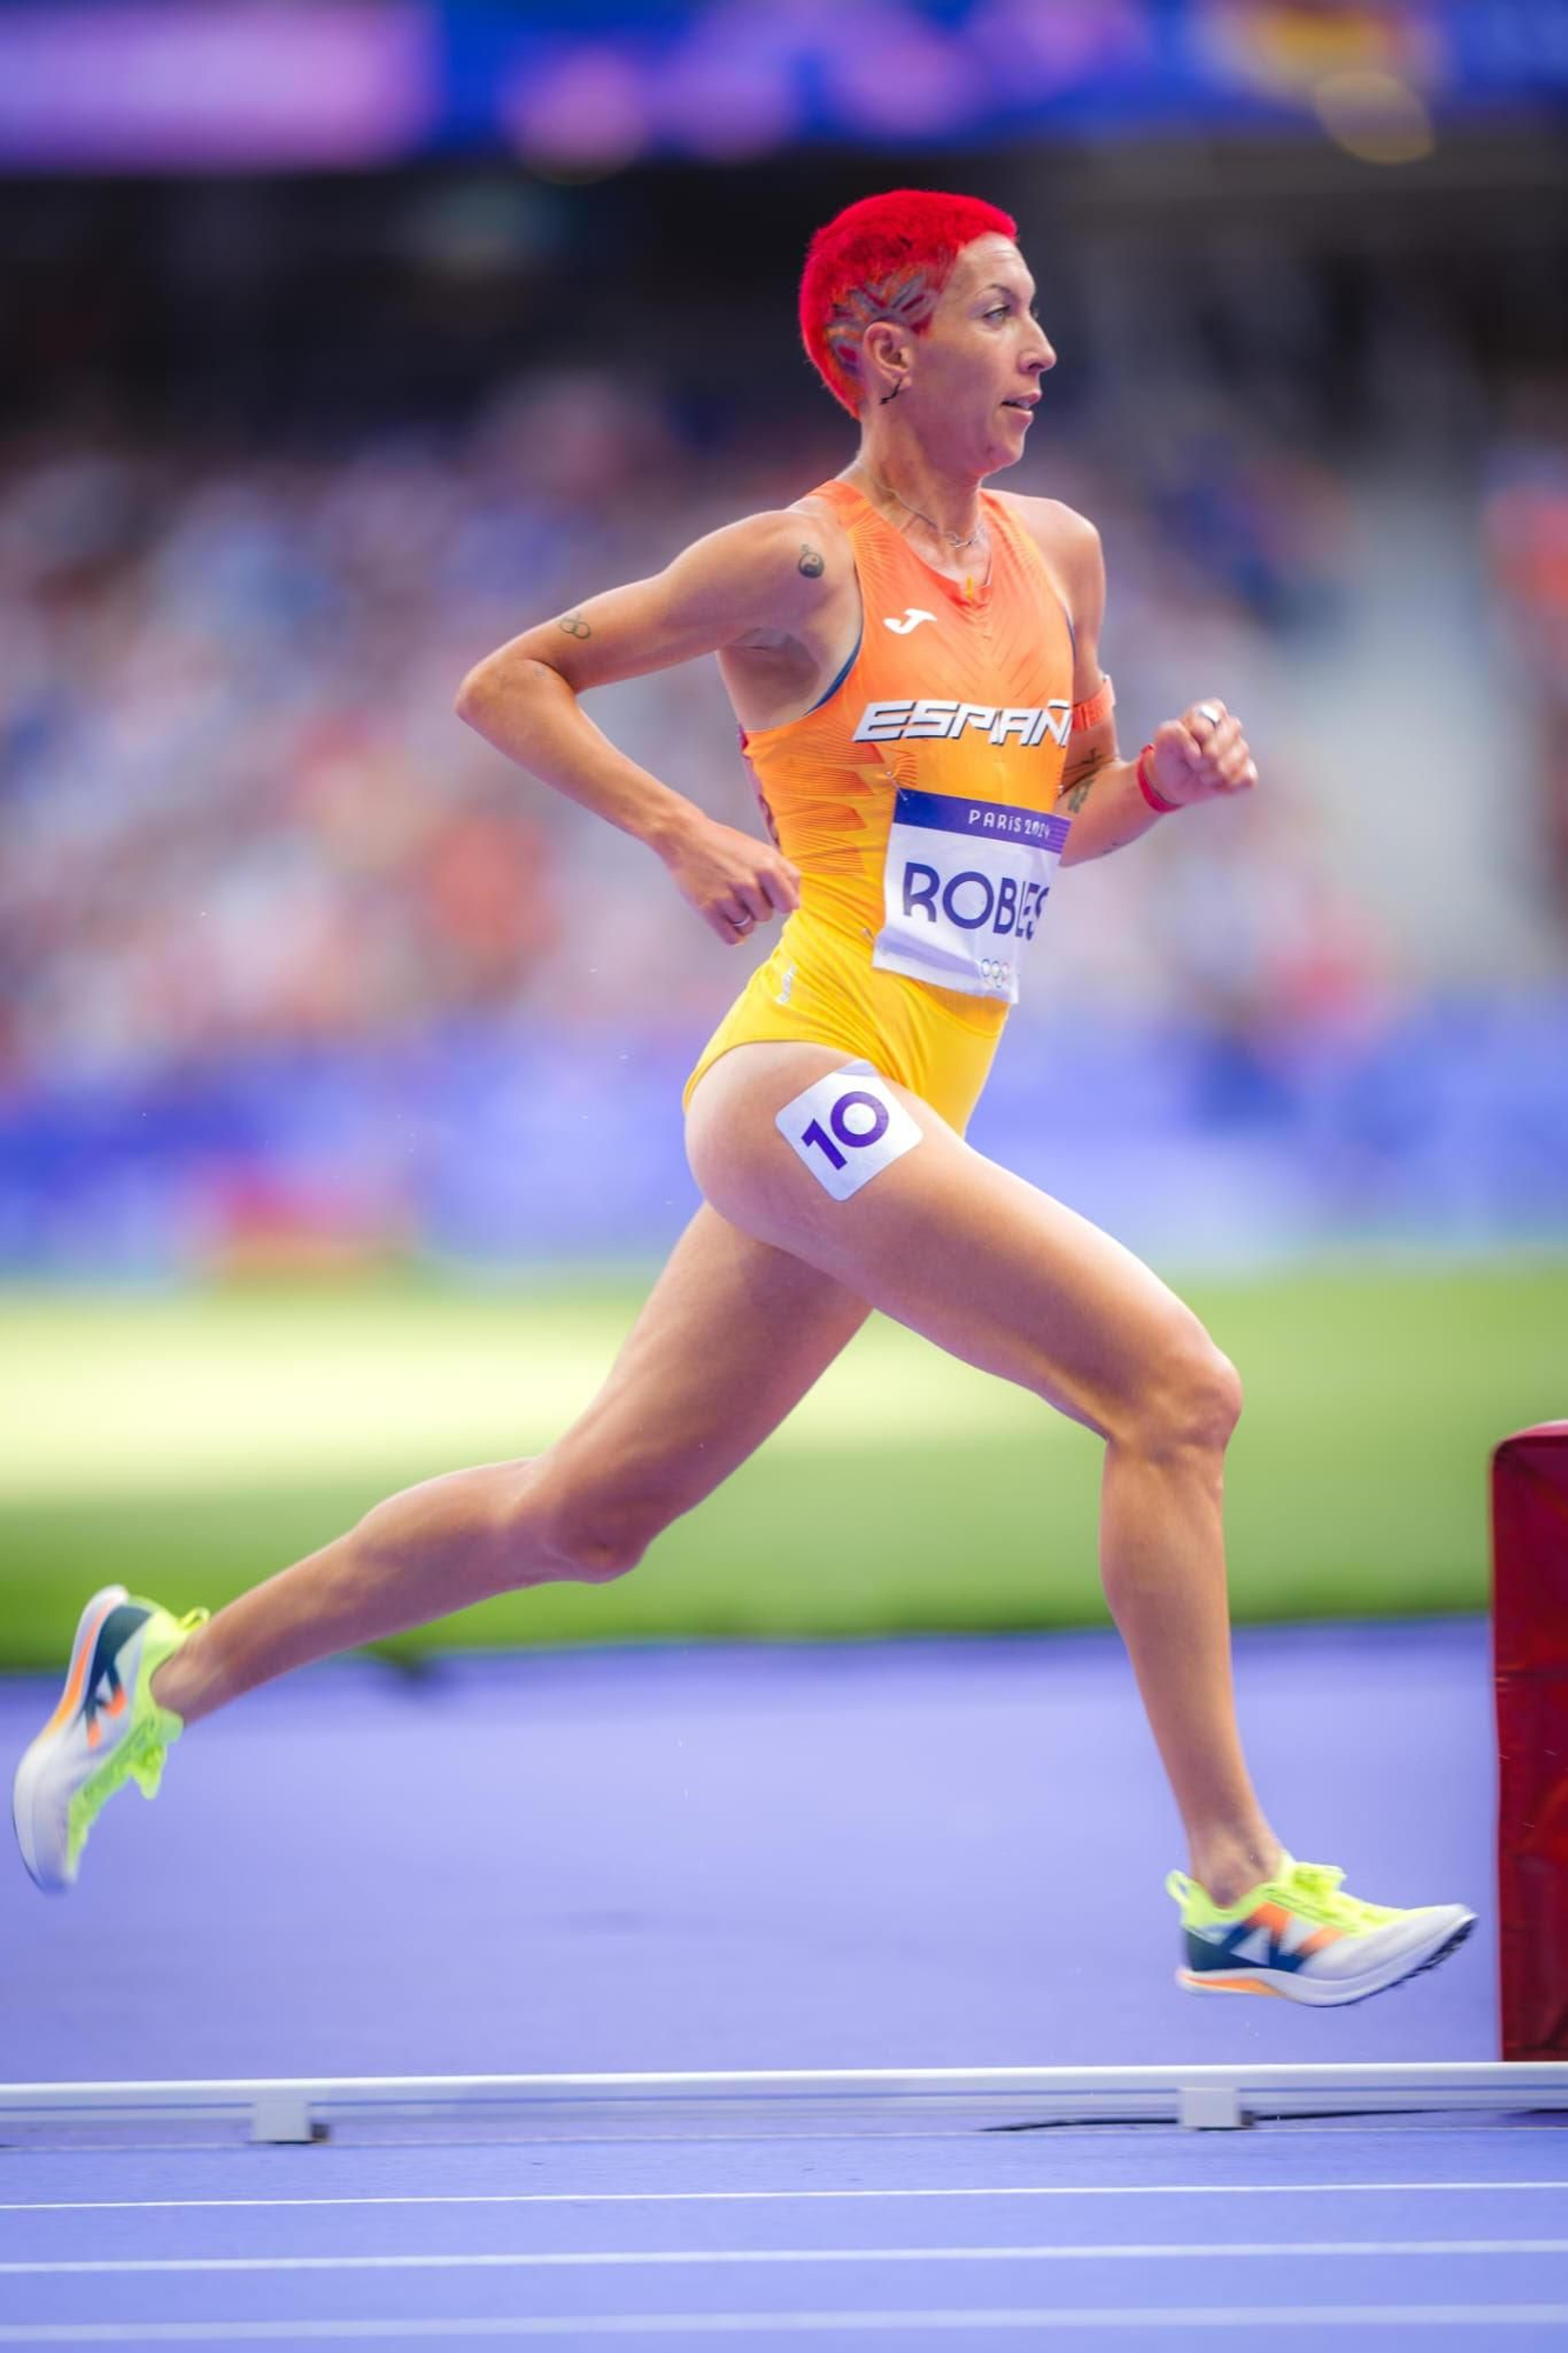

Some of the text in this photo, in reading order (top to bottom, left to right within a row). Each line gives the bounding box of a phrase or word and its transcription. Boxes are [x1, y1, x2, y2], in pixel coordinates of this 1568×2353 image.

[852, 699, 1070, 748] ESPAÑ
[1024, 819, 1051, 840] 2024
[801, 1091, 889, 1170] 10
